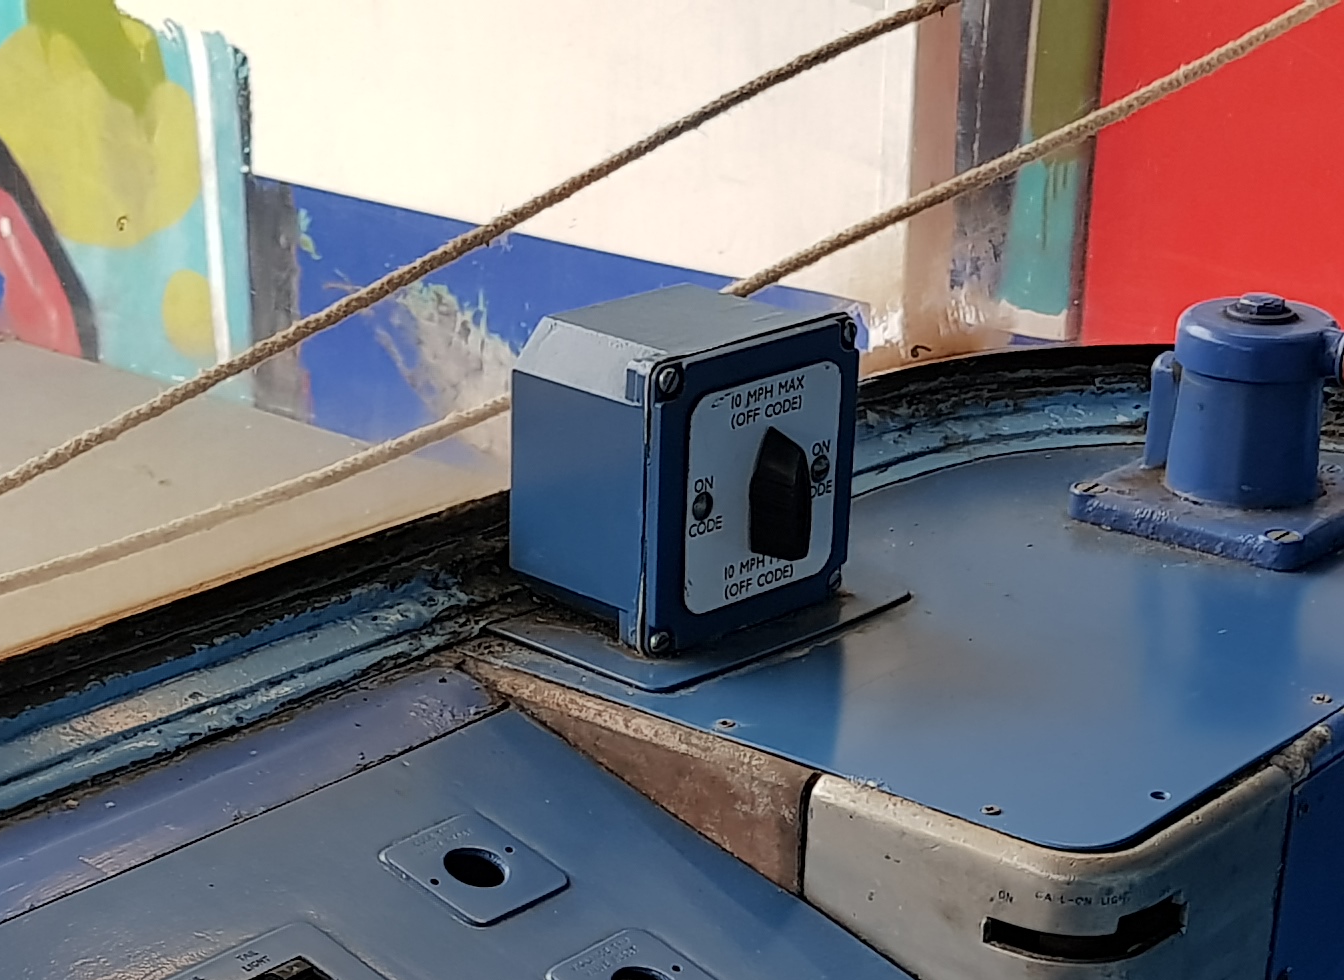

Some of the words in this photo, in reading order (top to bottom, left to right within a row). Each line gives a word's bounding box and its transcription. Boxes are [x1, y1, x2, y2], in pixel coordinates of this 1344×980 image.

[730, 393, 742, 410] 10
[746, 384, 774, 405] MPH
[778, 375, 805, 396] MAX
[731, 407, 761, 429] (OFF
[764, 395, 803, 418] CODE)
[812, 439, 831, 457] ON
[694, 475, 714, 493] ON
[811, 479, 833, 498] ODE
[688, 515, 723, 538] CODE
[724, 564, 735, 580] 10
[739, 554, 765, 575] MPH
[724, 577, 753, 600] (OFF
[757, 563, 794, 588] CODE)
[235, 950, 260, 963] TAIL
[241, 955, 271, 972] LIGHT
